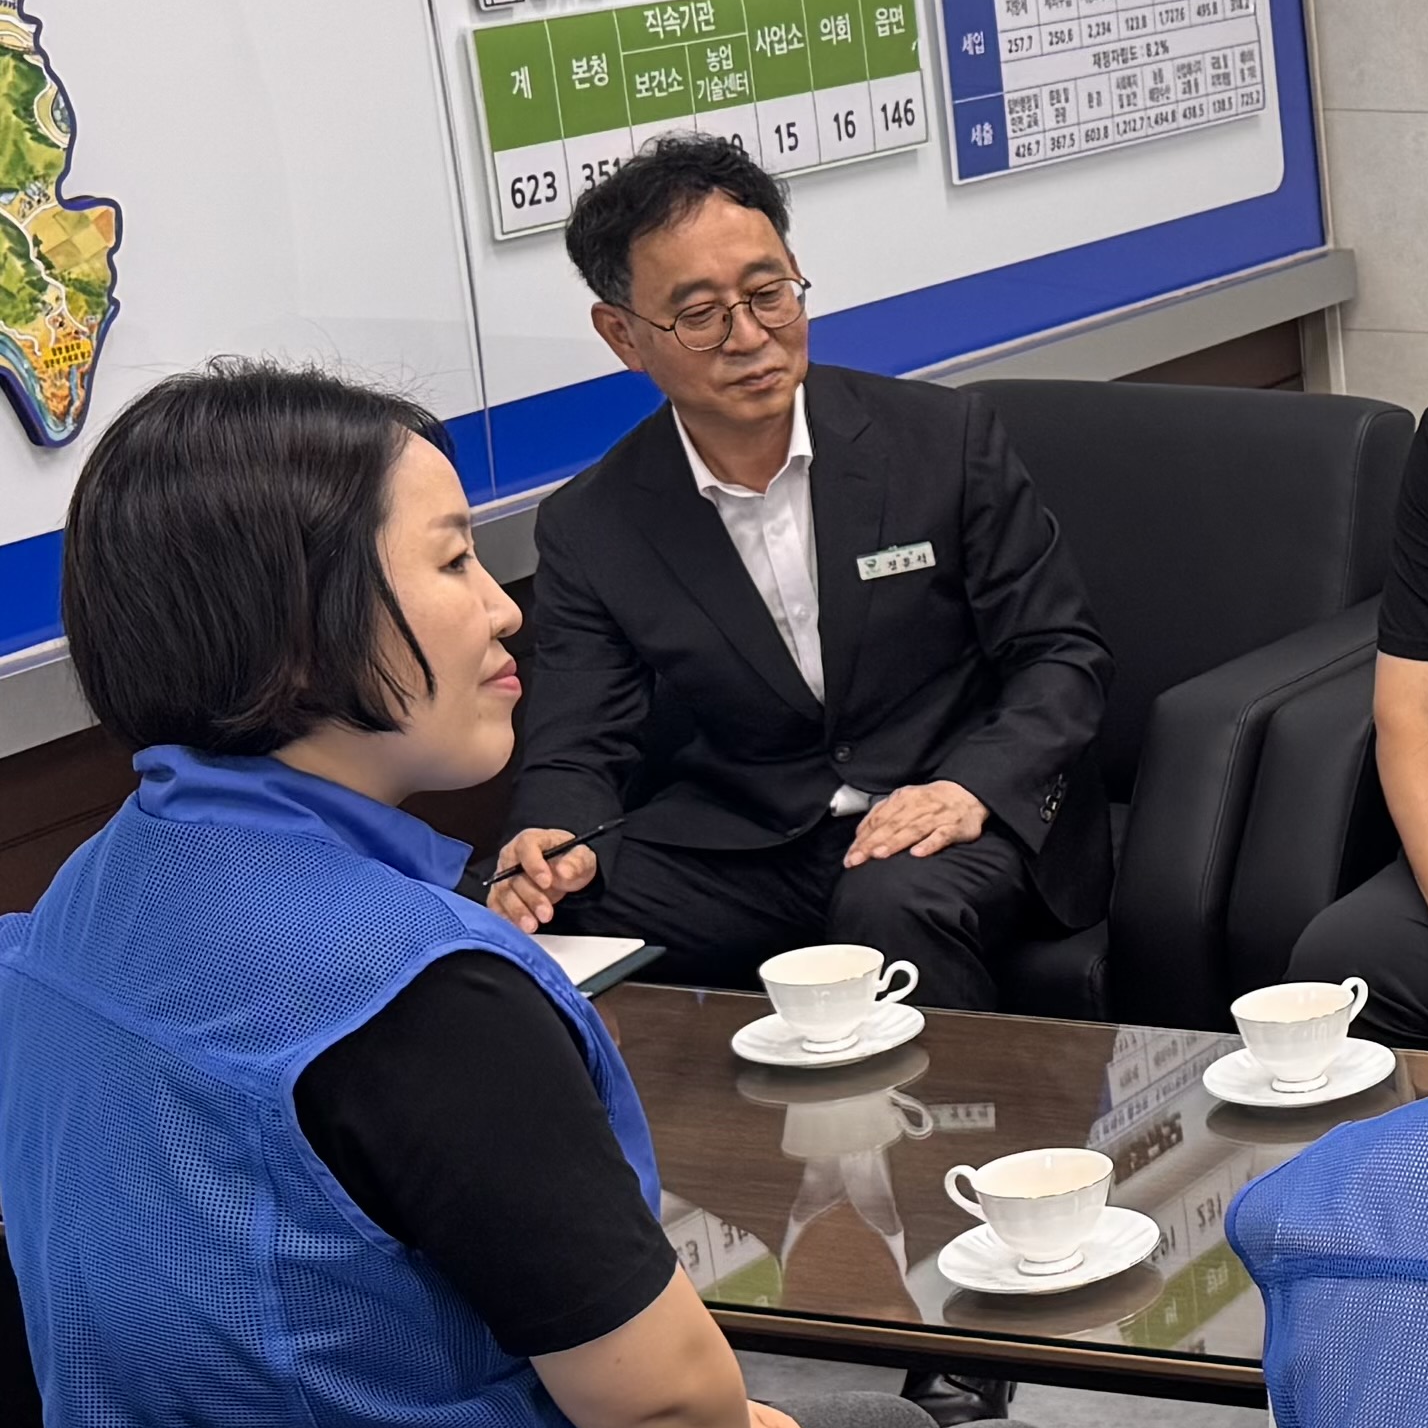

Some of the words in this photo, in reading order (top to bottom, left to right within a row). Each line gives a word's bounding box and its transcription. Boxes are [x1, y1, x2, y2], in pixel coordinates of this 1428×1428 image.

[644, 0, 715, 39] 직속기관
[820, 14, 852, 44] 의회
[875, 5, 905, 37] 읍면
[1088, 22, 1111, 38] 2,234
[755, 24, 804, 57] 사업소
[962, 32, 984, 56] 세입
[1008, 36, 1033, 53] 257.7
[1049, 28, 1074, 45] 250.6
[571, 53, 609, 90] 본청
[707, 44, 732, 71] 농업
[512, 66, 531, 100] 계
[635, 68, 684, 99] 보건소
[697, 71, 749, 103] 기술센터
[833, 110, 856, 142] 16
[880, 98, 915, 132] 146
[775, 122, 798, 154] 15
[971, 121, 994, 147] 세출
[1015, 140, 1040, 158] 426.7
[1050, 135, 1076, 153] 367.5
[510, 171, 557, 209] 623
